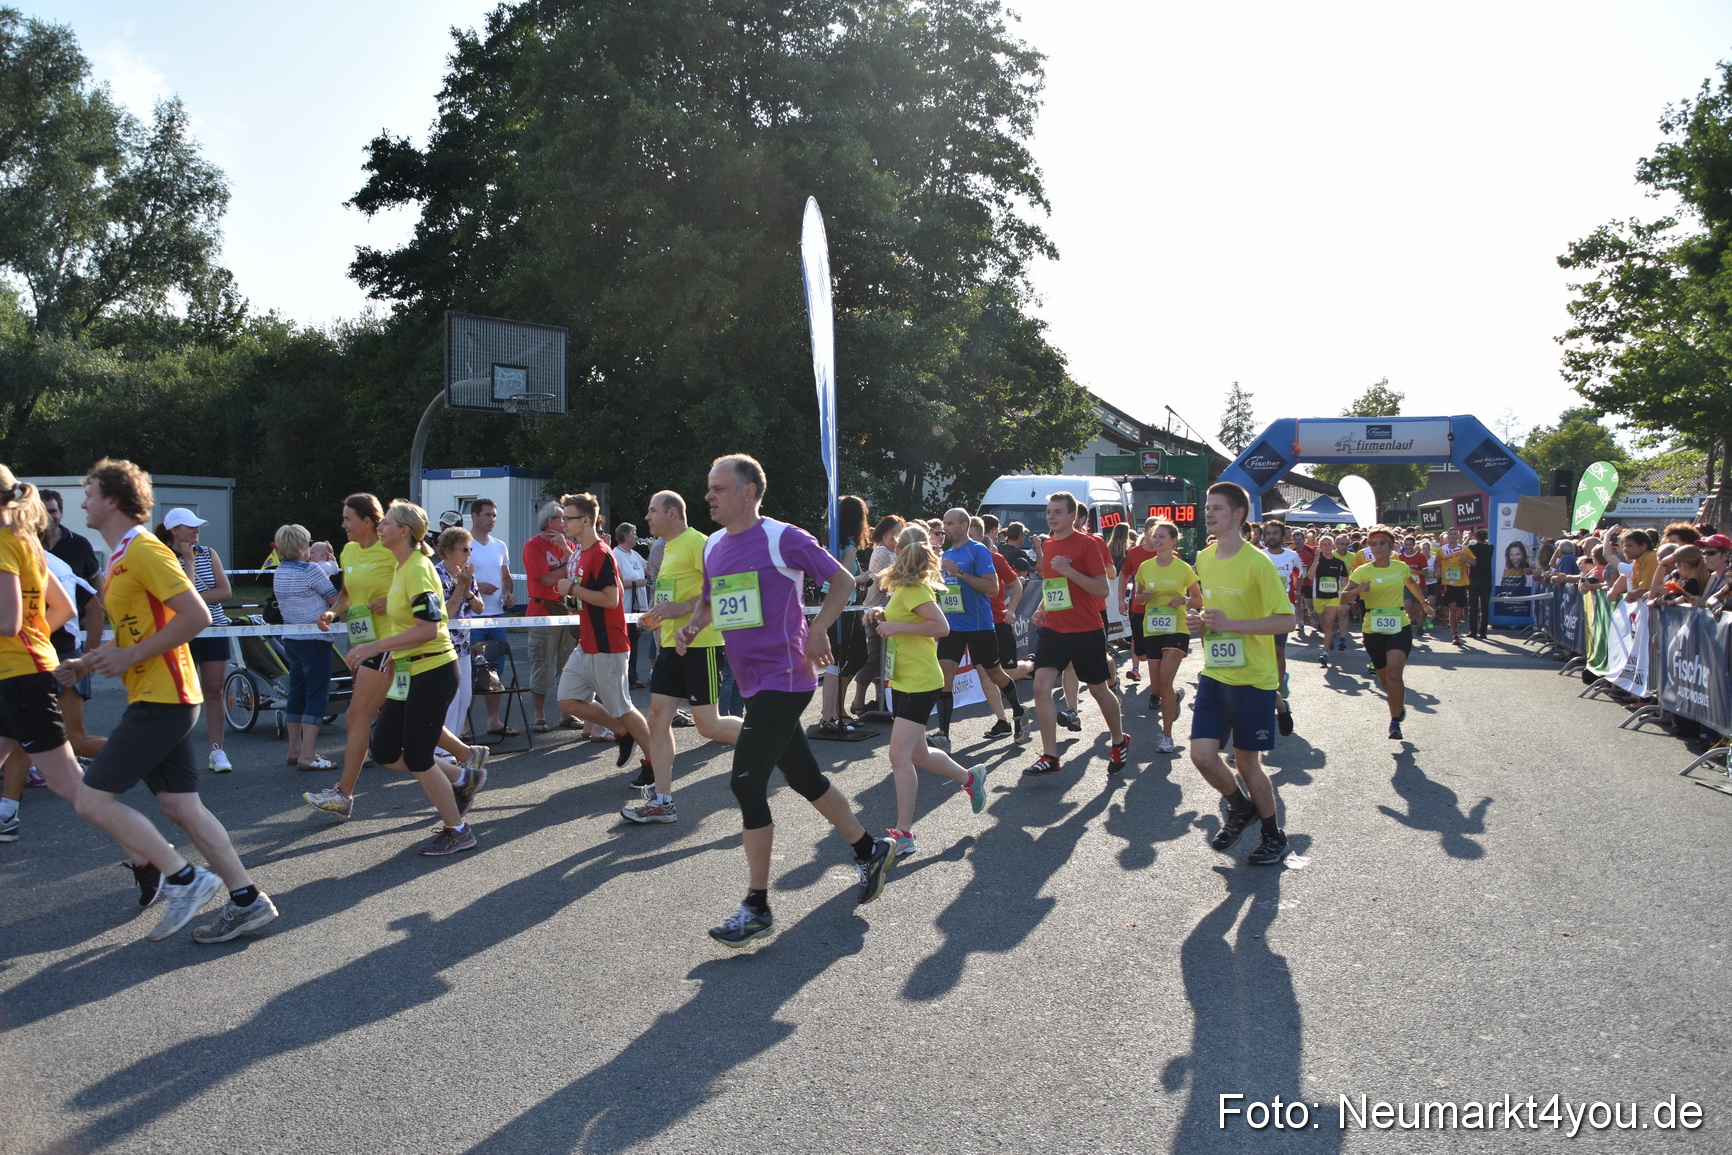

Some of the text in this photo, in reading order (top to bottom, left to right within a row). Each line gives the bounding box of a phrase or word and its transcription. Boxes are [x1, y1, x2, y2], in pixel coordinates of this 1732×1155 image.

[1356, 439, 1415, 450] firmenlauf
[1623, 496, 1647, 504] Jura
[1456, 501, 1475, 516] RW
[1574, 500, 1597, 525] AOK
[1422, 512, 1437, 523] RW
[943, 596, 958, 607] 489
[1046, 590, 1064, 602] 972
[718, 594, 748, 616] 291
[350, 620, 369, 635] 664
[1151, 616, 1171, 627] 662
[1376, 617, 1396, 628] 630
[1211, 642, 1236, 658] 650
[1672, 650, 1710, 689] Fischer
